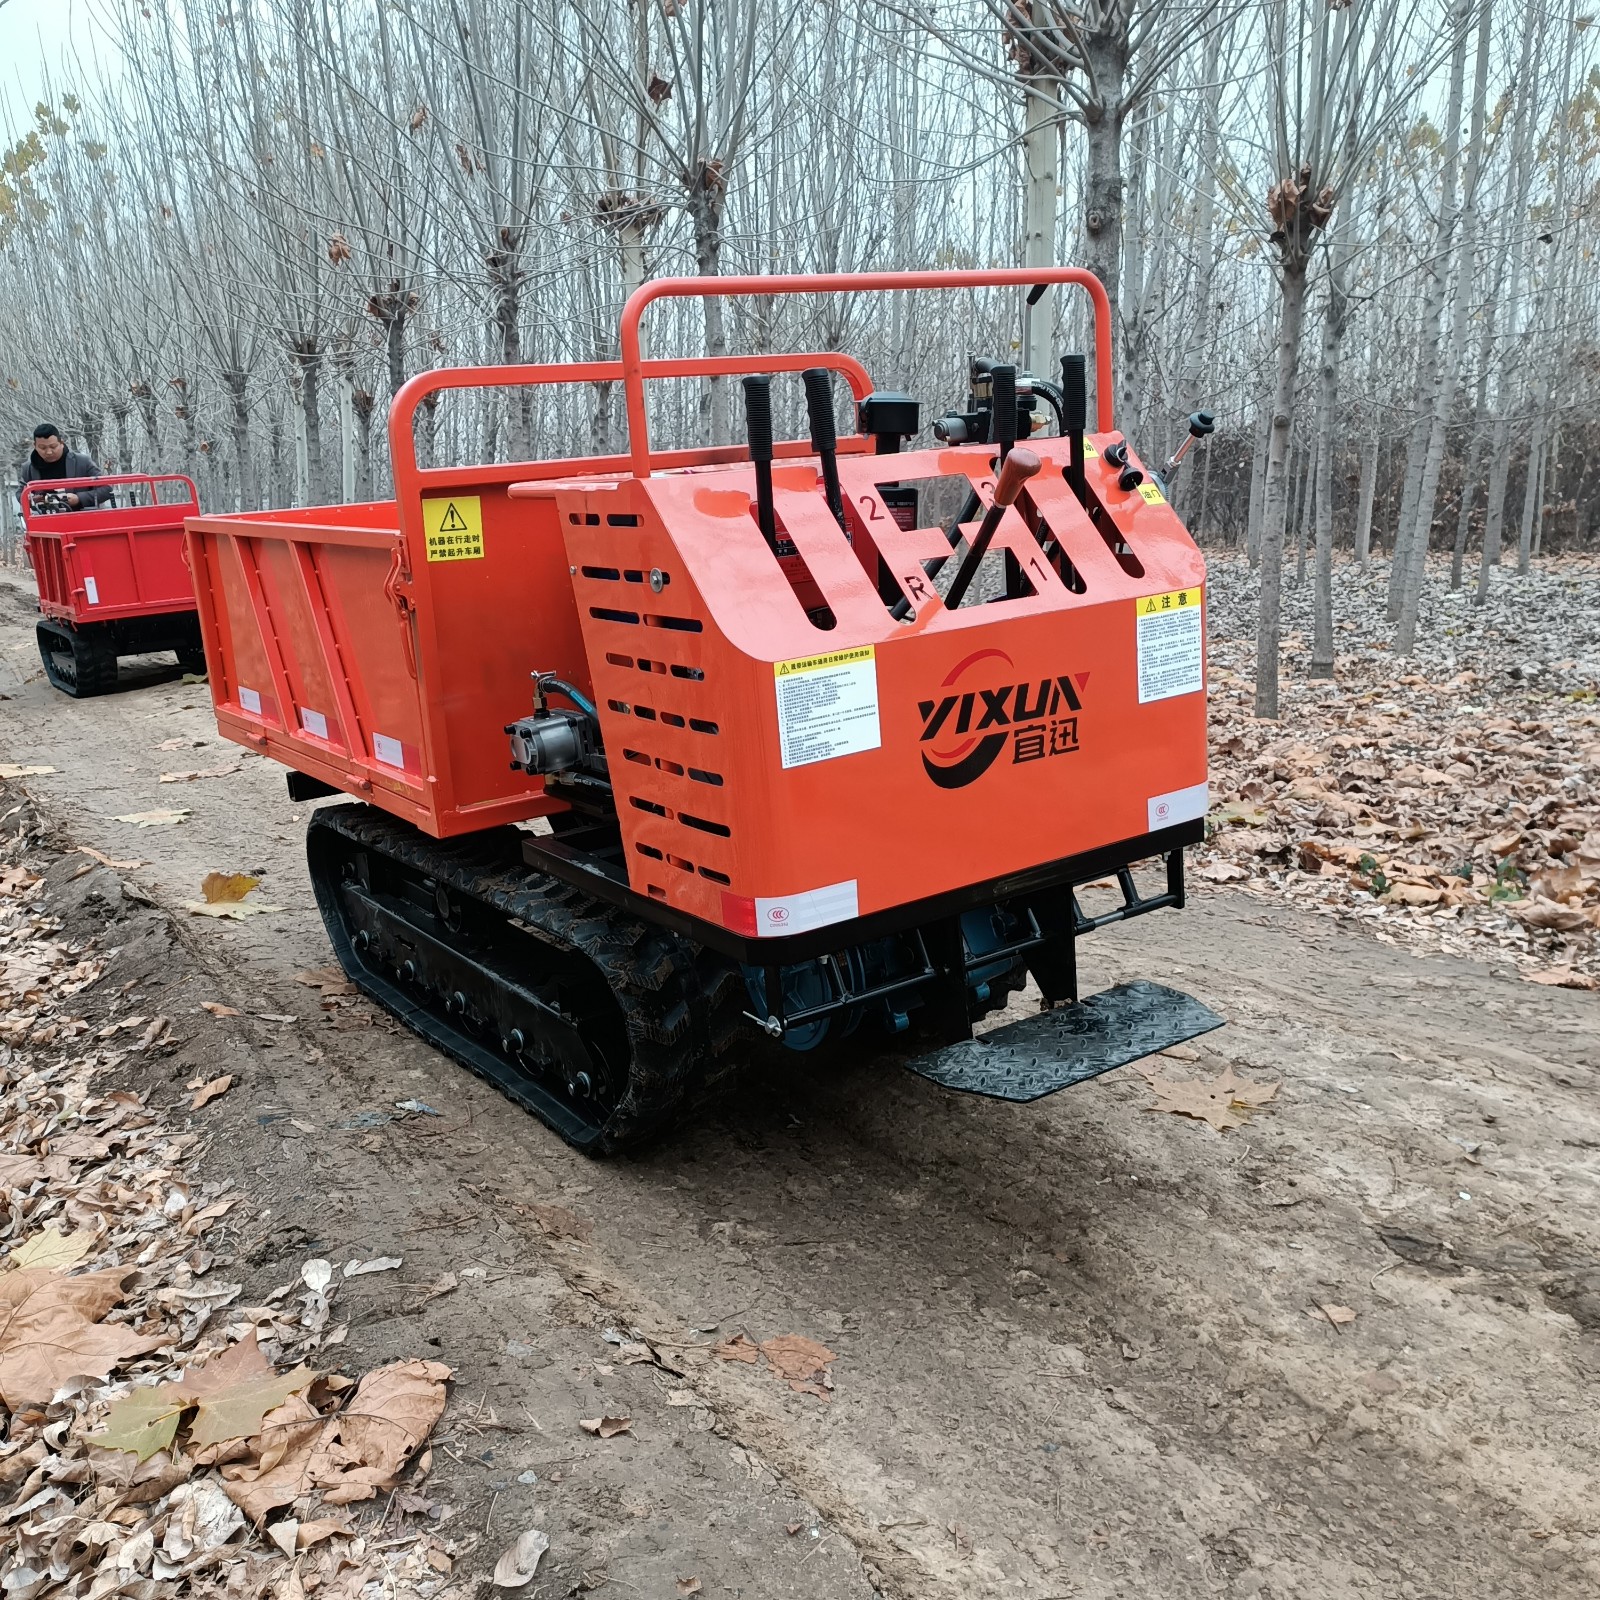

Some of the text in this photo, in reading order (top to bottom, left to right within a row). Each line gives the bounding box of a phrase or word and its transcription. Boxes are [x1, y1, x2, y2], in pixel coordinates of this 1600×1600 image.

[1142, 489, 1161, 499] 油门
[859, 495, 885, 521] 2
[429, 534, 480, 546] 机器在行走时
[430, 546, 481, 558] 严禁起升车厢
[1029, 557, 1047, 581] 1
[904, 576, 933, 601] R
[1162, 592, 1187, 609] 注意
[918, 672, 1090, 741] YIXUN
[1012, 717, 1079, 764] 宜迅
